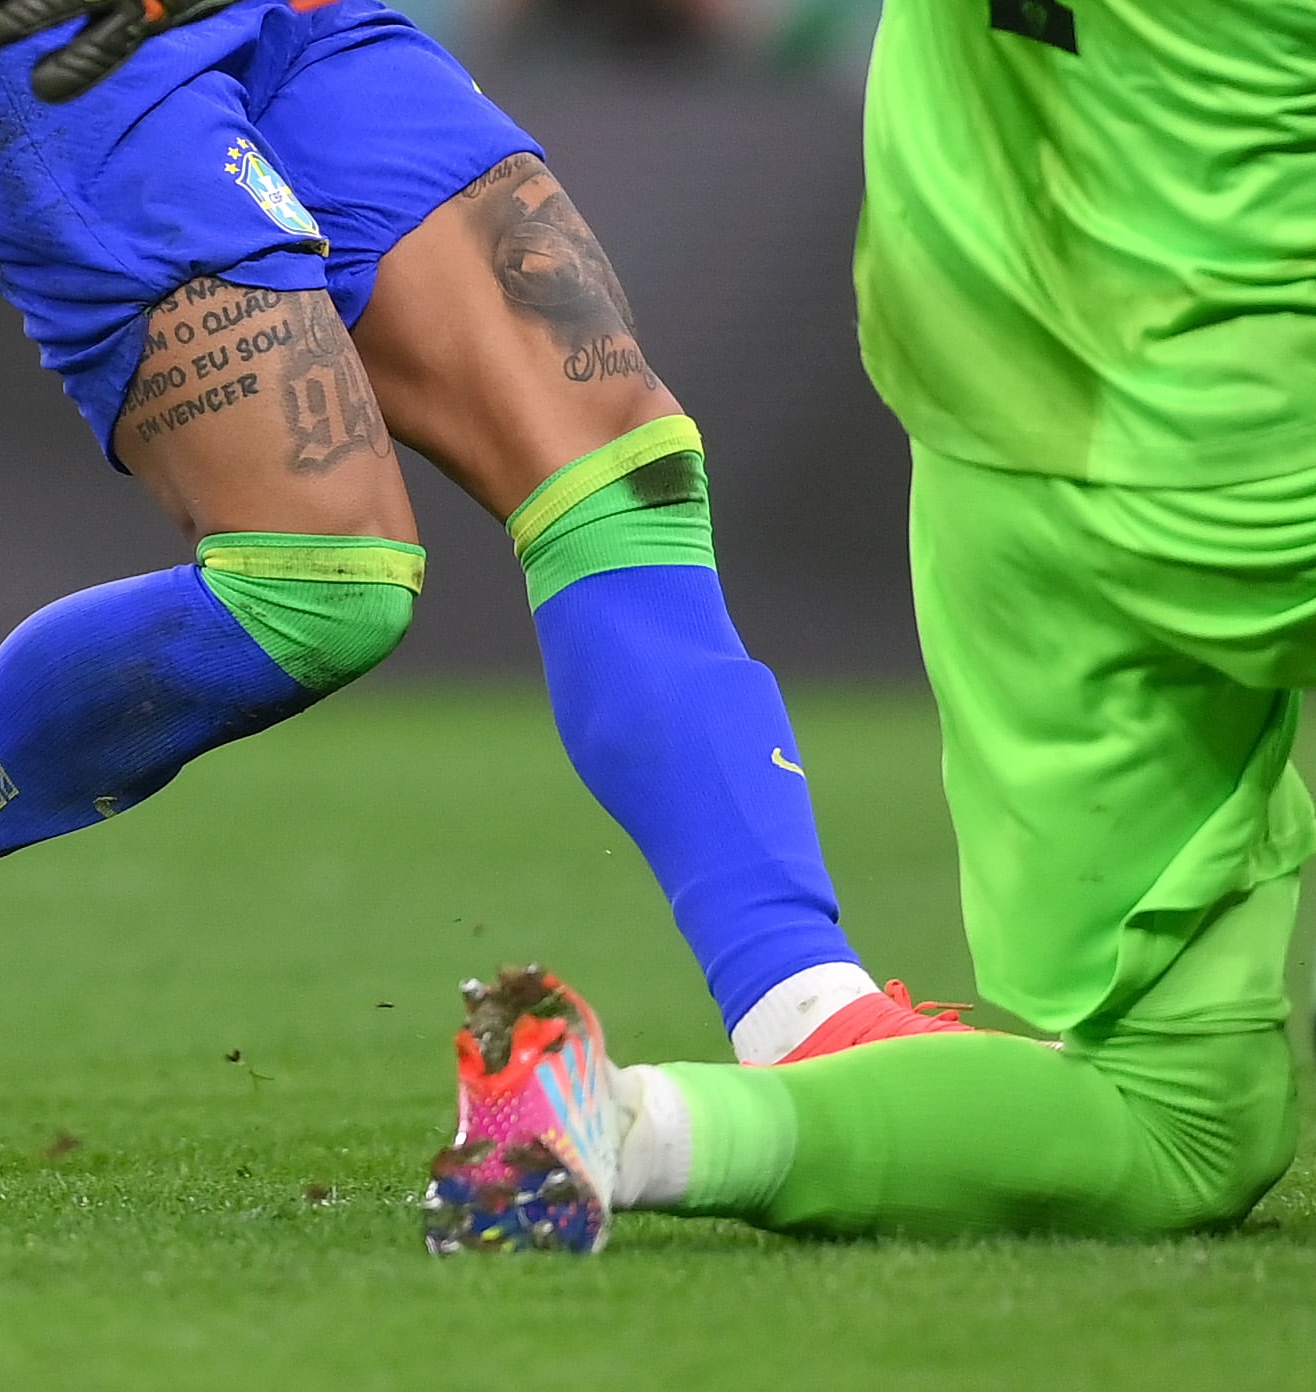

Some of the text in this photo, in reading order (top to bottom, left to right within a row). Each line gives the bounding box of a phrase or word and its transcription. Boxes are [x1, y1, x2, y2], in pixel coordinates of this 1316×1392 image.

[174, 321, 195, 344] O
[191, 346, 230, 380] EU
[236, 319, 293, 362] SOU
[159, 372, 260, 431] VENCER
